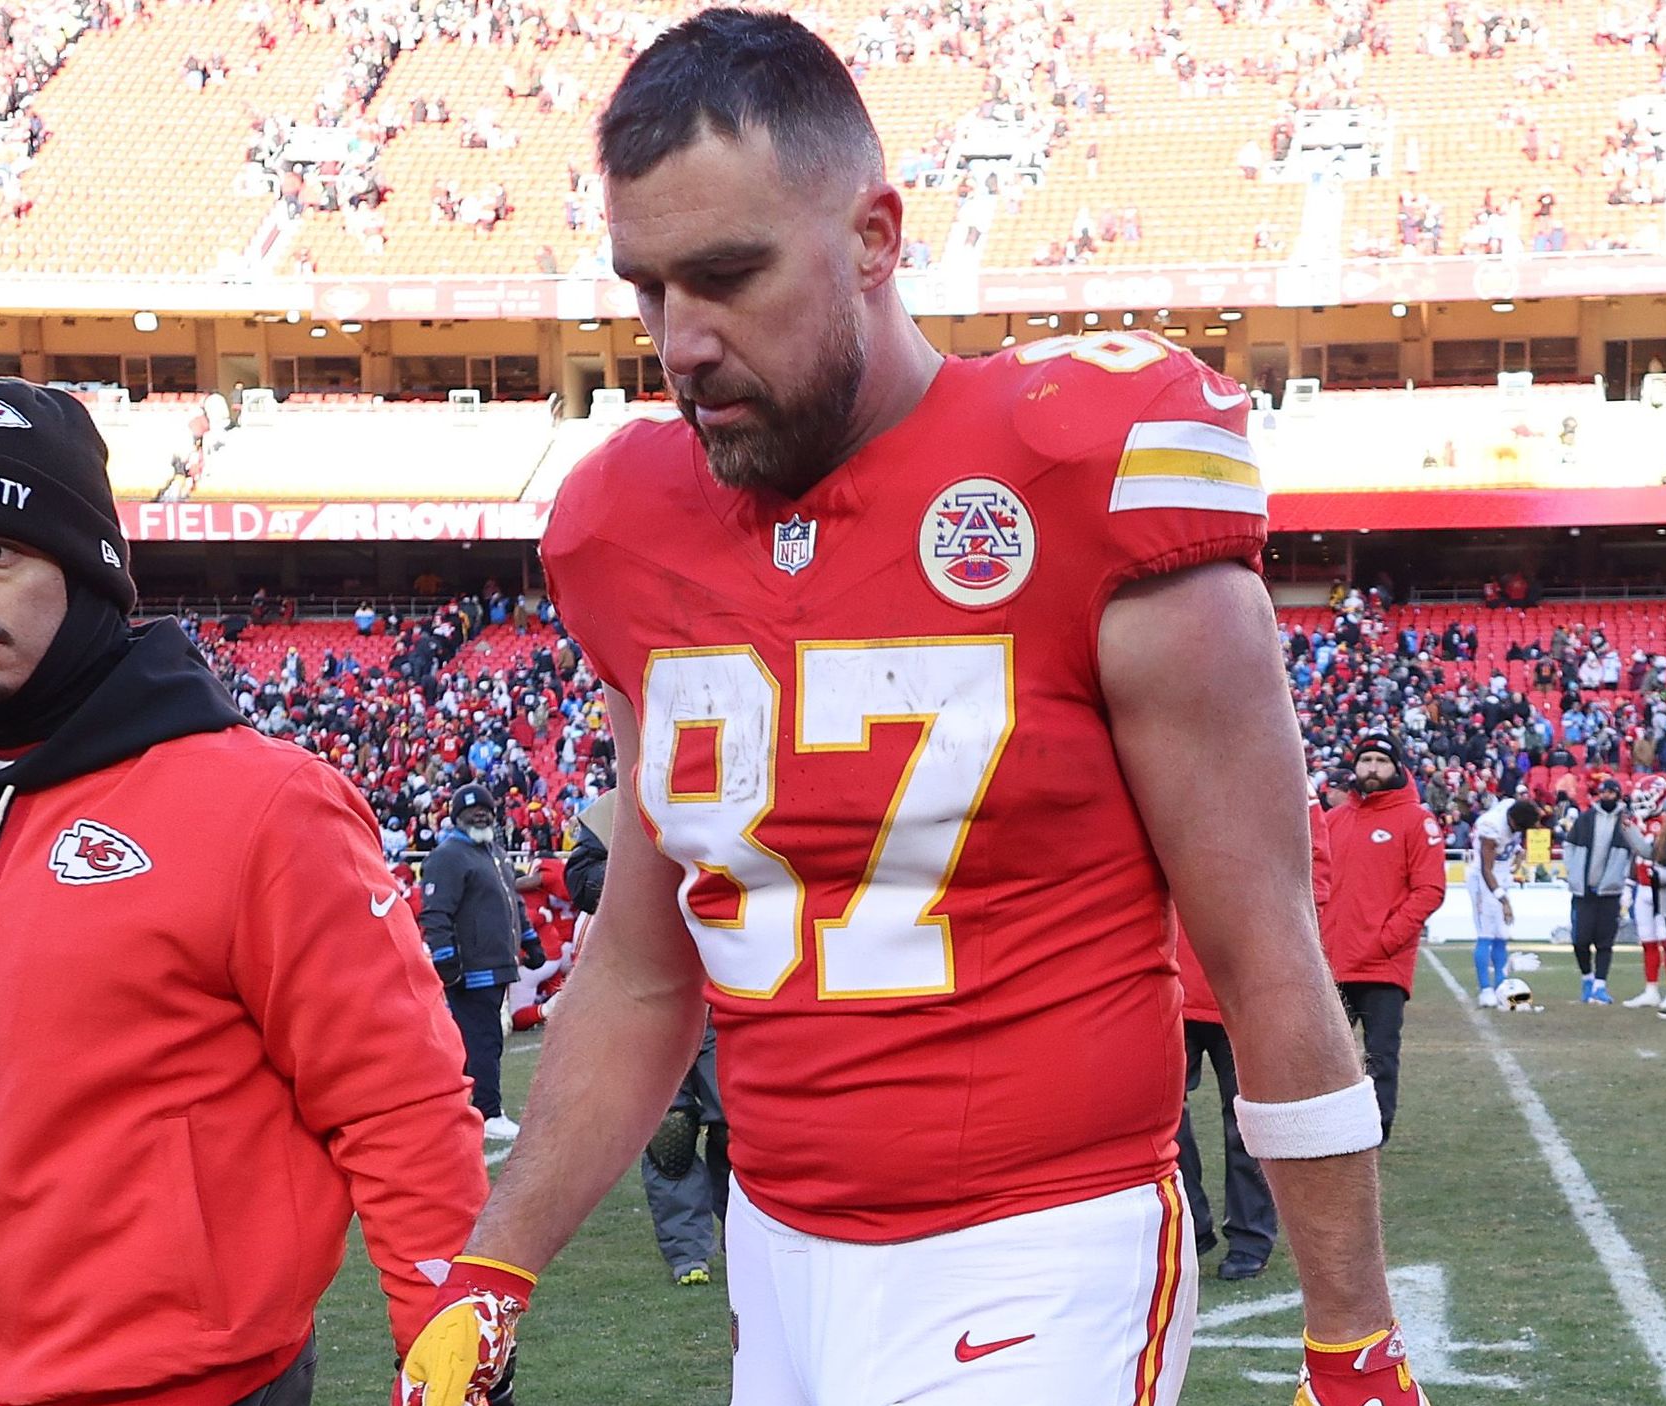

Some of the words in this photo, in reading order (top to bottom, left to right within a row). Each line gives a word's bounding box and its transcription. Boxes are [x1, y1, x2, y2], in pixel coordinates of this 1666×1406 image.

[138, 502, 263, 541] FIELD
[266, 509, 304, 534] AT
[298, 502, 550, 541] ARROWHE
[780, 541, 807, 565] NFL
[636, 633, 1017, 1001] 87
[75, 835, 126, 872] KC
